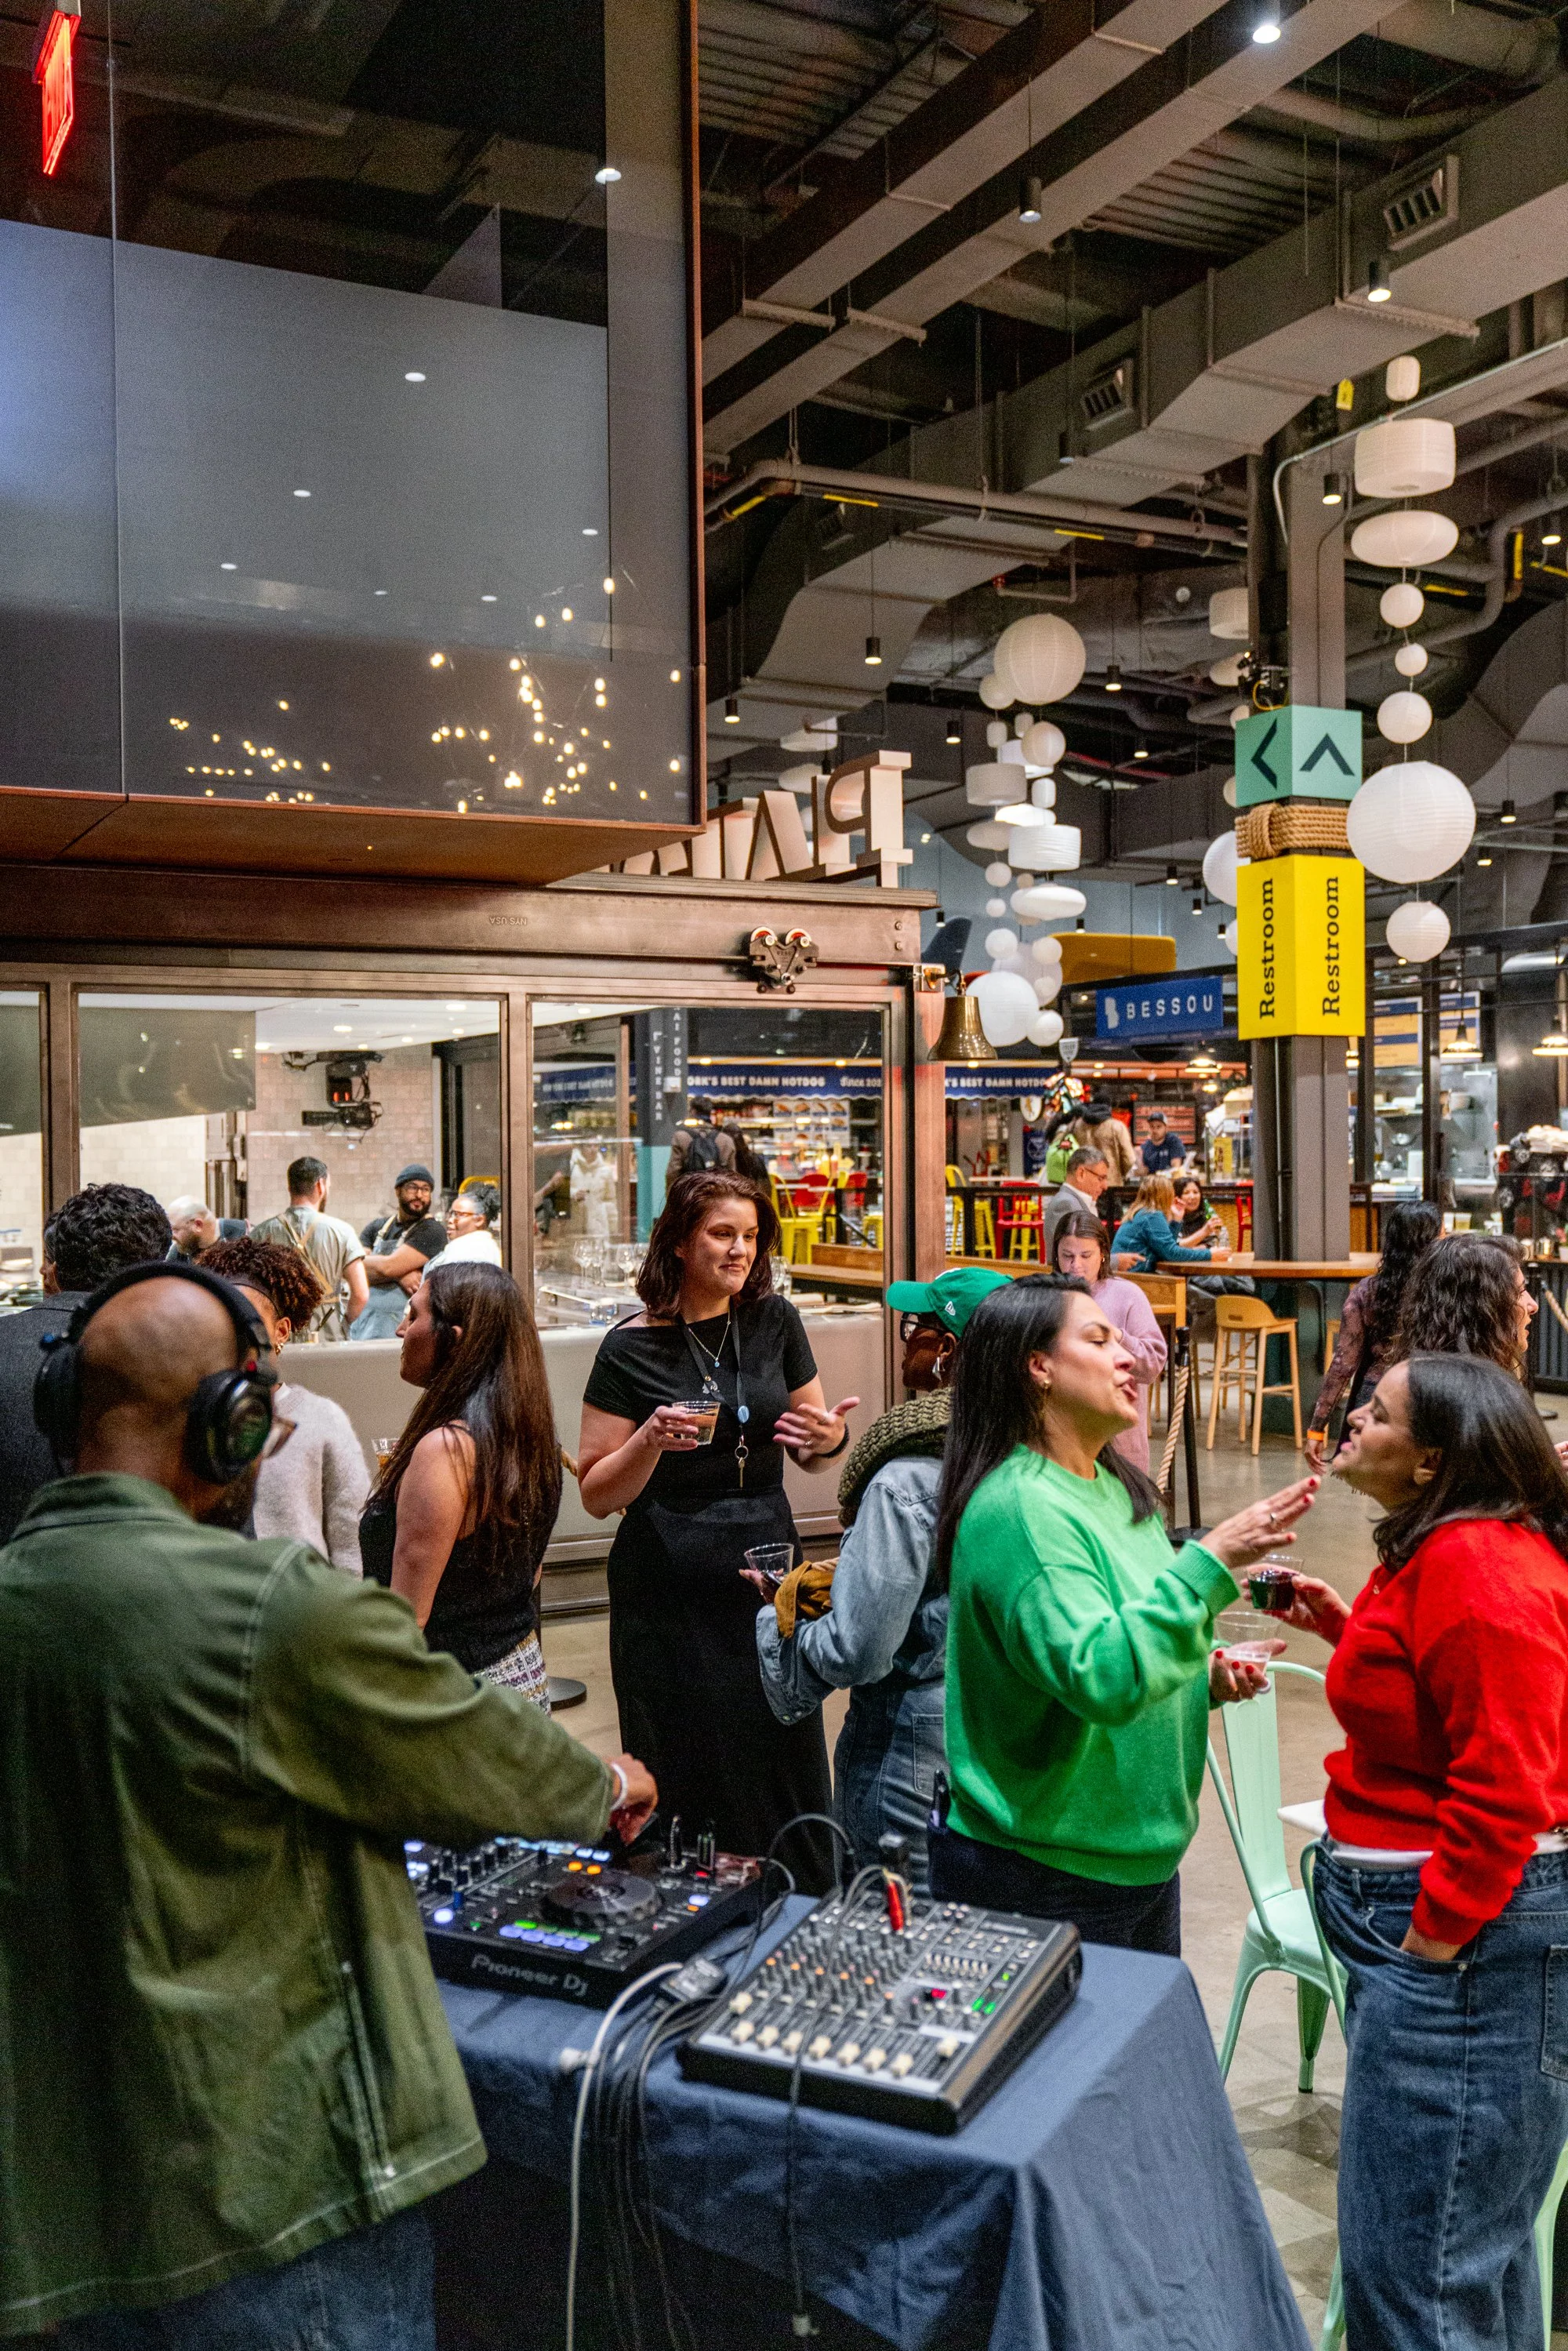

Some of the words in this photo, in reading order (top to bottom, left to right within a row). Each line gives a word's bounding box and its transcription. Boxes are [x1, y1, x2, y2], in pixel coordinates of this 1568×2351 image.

[510, 917, 527, 925] NYS
[1259, 878, 1275, 1019] Restroom
[1323, 876, 1340, 1016] Restroom
[1127, 994, 1213, 1019] BESSOU
[720, 1076, 746, 1087] BEST
[748, 1077, 779, 1087] DAMN
[782, 1077, 826, 1087] HOTDOG
[960, 1077, 983, 1088] BEST
[985, 1077, 1013, 1088] DAMN
[471, 1953, 558, 1986] Pioneer
[563, 1973, 589, 1997] DJ
